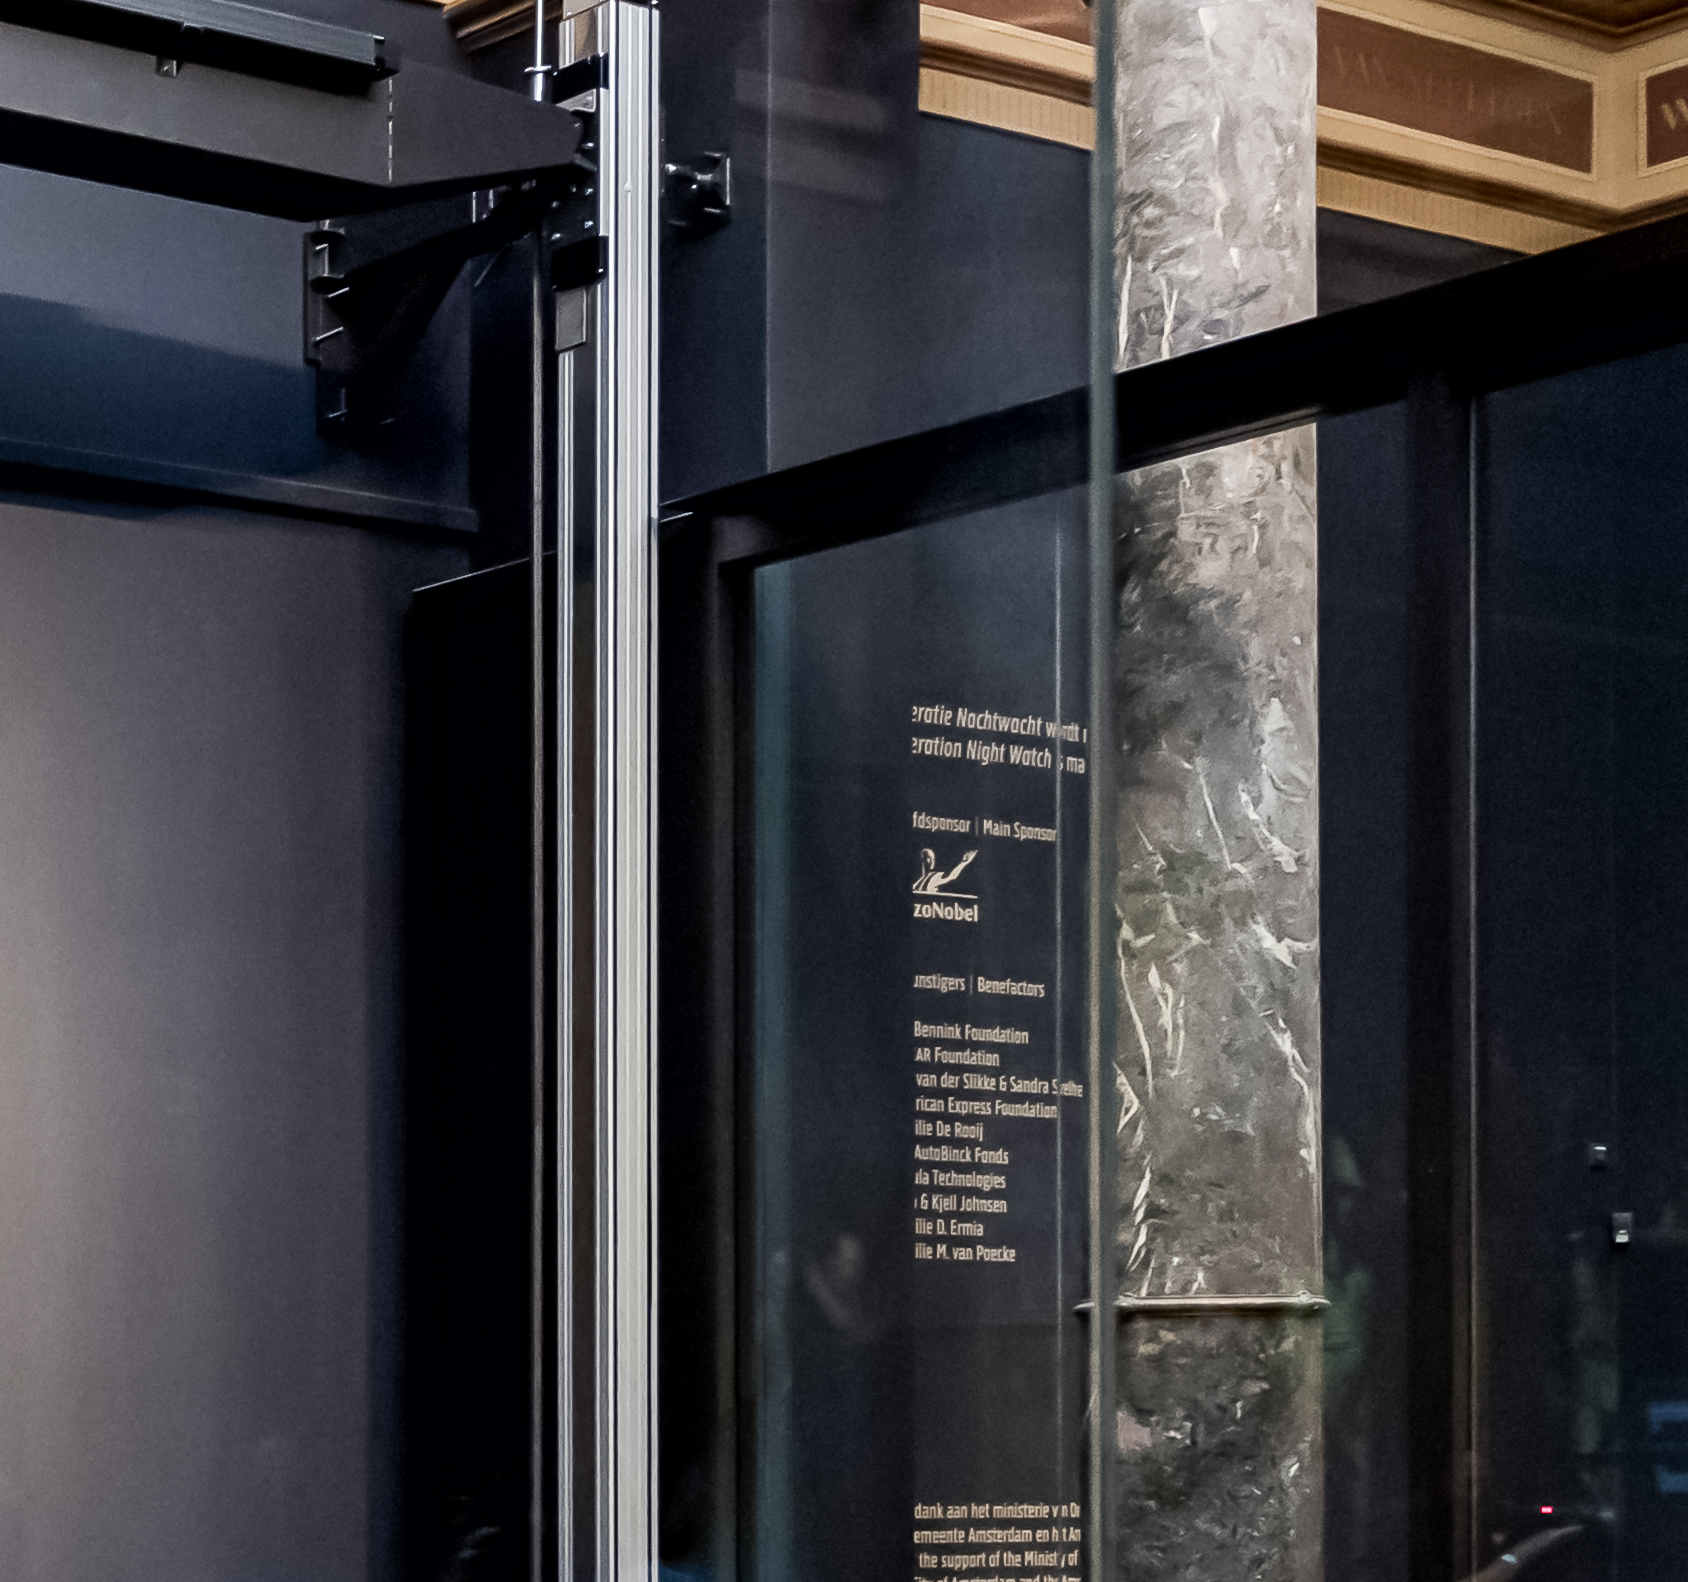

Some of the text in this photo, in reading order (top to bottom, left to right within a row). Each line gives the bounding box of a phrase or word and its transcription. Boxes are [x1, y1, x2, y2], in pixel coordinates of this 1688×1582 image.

[957, 708, 1042, 736] Nachtwacht
[1046, 721, 1080, 742] wrdt
[967, 740, 1005, 766] Night
[1010, 745, 1051, 769] Watch
[983, 819, 1010, 837] Main
[1013, 822, 1057, 842] Sponsor
[913, 902, 978, 922] zoNobel
[977, 976, 1045, 998] Benefactors
[914, 1020, 1029, 1044] Bennink Foundation
[934, 1046, 1000, 1067] Foundation
[916, 1073, 937, 1088] van
[940, 1071, 960, 1089] der
[963, 1073, 996, 1091] Slikke
[999, 1075, 1007, 1092] &
[1009, 1075, 1049, 1094] Sandra
[916, 1095, 1058, 1119] rican Express Foundation
[936, 1120, 951, 1137] De
[954, 1121, 983, 1142] Rooij
[914, 1144, 1009, 1165] AutoBinck Fonds
[932, 1169, 1007, 1191] Technologies
[931, 1194, 957, 1213] Kjell
[959, 1195, 1007, 1213] Johnsen
[950, 1219, 984, 1237] Ermia
[952, 1247, 973, 1261] van
[914, 1502, 944, 1519] dank
[946, 1505, 968, 1519] aan
[971, 1502, 990, 1519] het
[992, 1502, 1050, 1519] ministerie
[1051, 1505, 1069, 1518] vn
[914, 1527, 965, 1544] emeente
[968, 1526, 1033, 1543] Amsterdam
[1035, 1529, 1050, 1543] en
[1051, 1526, 1067, 1542] ht
[919, 1549, 1079, 1571] the support of the Ministy of
